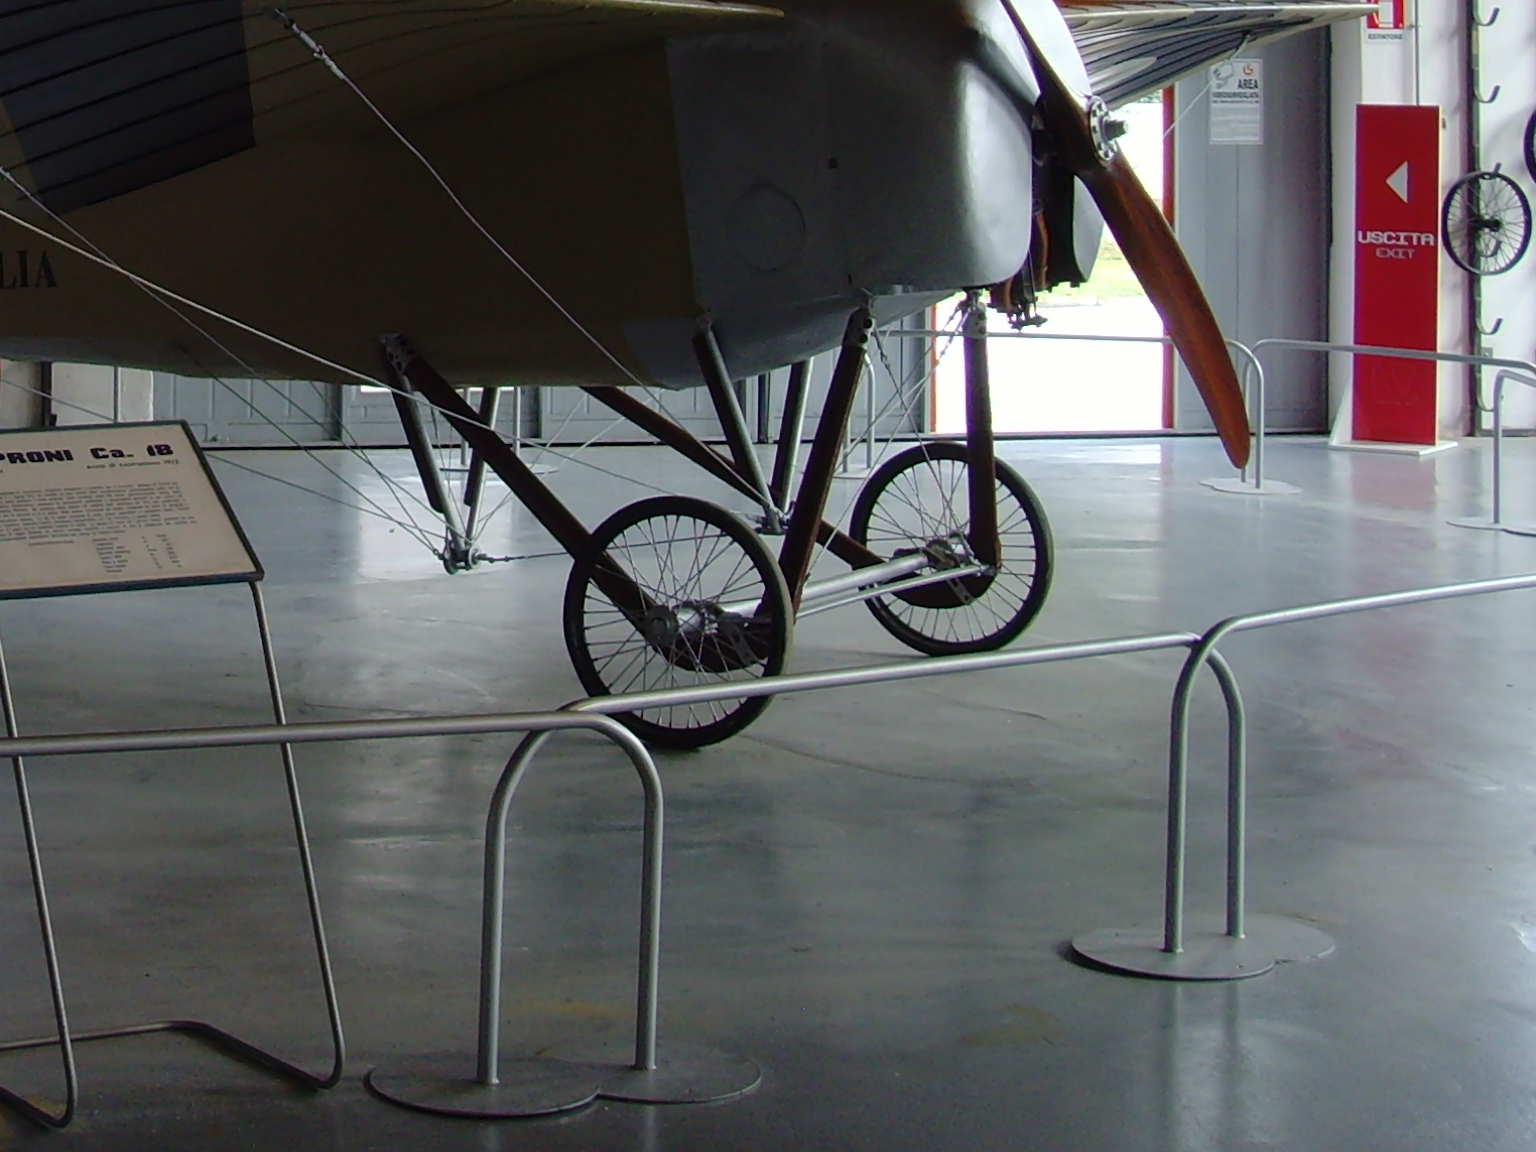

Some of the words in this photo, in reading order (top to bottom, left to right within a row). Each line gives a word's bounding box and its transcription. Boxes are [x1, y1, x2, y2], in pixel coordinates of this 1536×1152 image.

[1237, 79, 1259, 89] AREA
[1358, 230, 1435, 246] USCITA
[1375, 248, 1415, 259] EXIT
[90, 447, 134, 460] Ca.
[146, 444, 174, 457] 18
